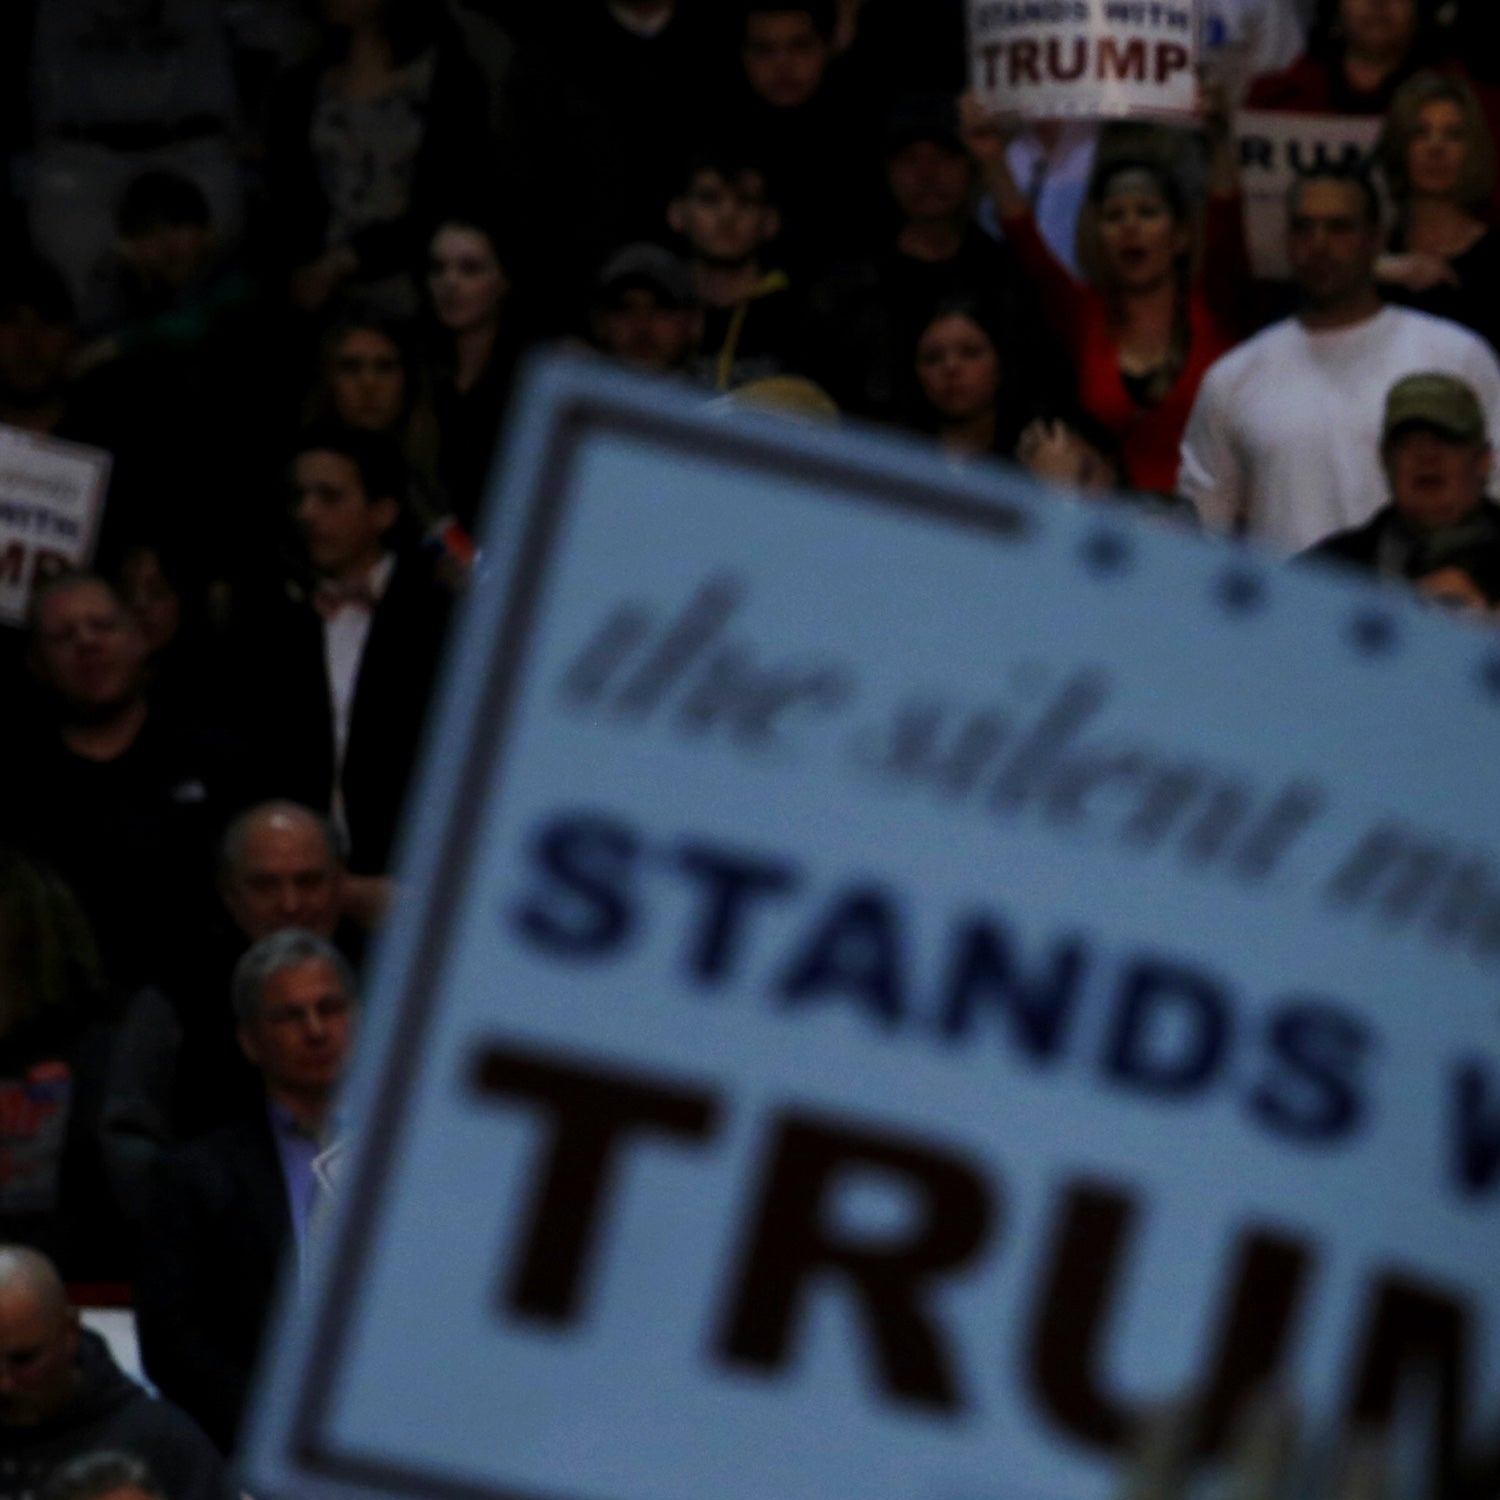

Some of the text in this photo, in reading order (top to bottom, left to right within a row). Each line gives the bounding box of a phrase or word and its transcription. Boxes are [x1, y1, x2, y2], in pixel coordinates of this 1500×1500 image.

[981, 37, 1189, 90] TRUMP
[560, 568, 858, 757] the
[872, 662, 1328, 884] silent
[511, 815, 1378, 1148] STANDS
